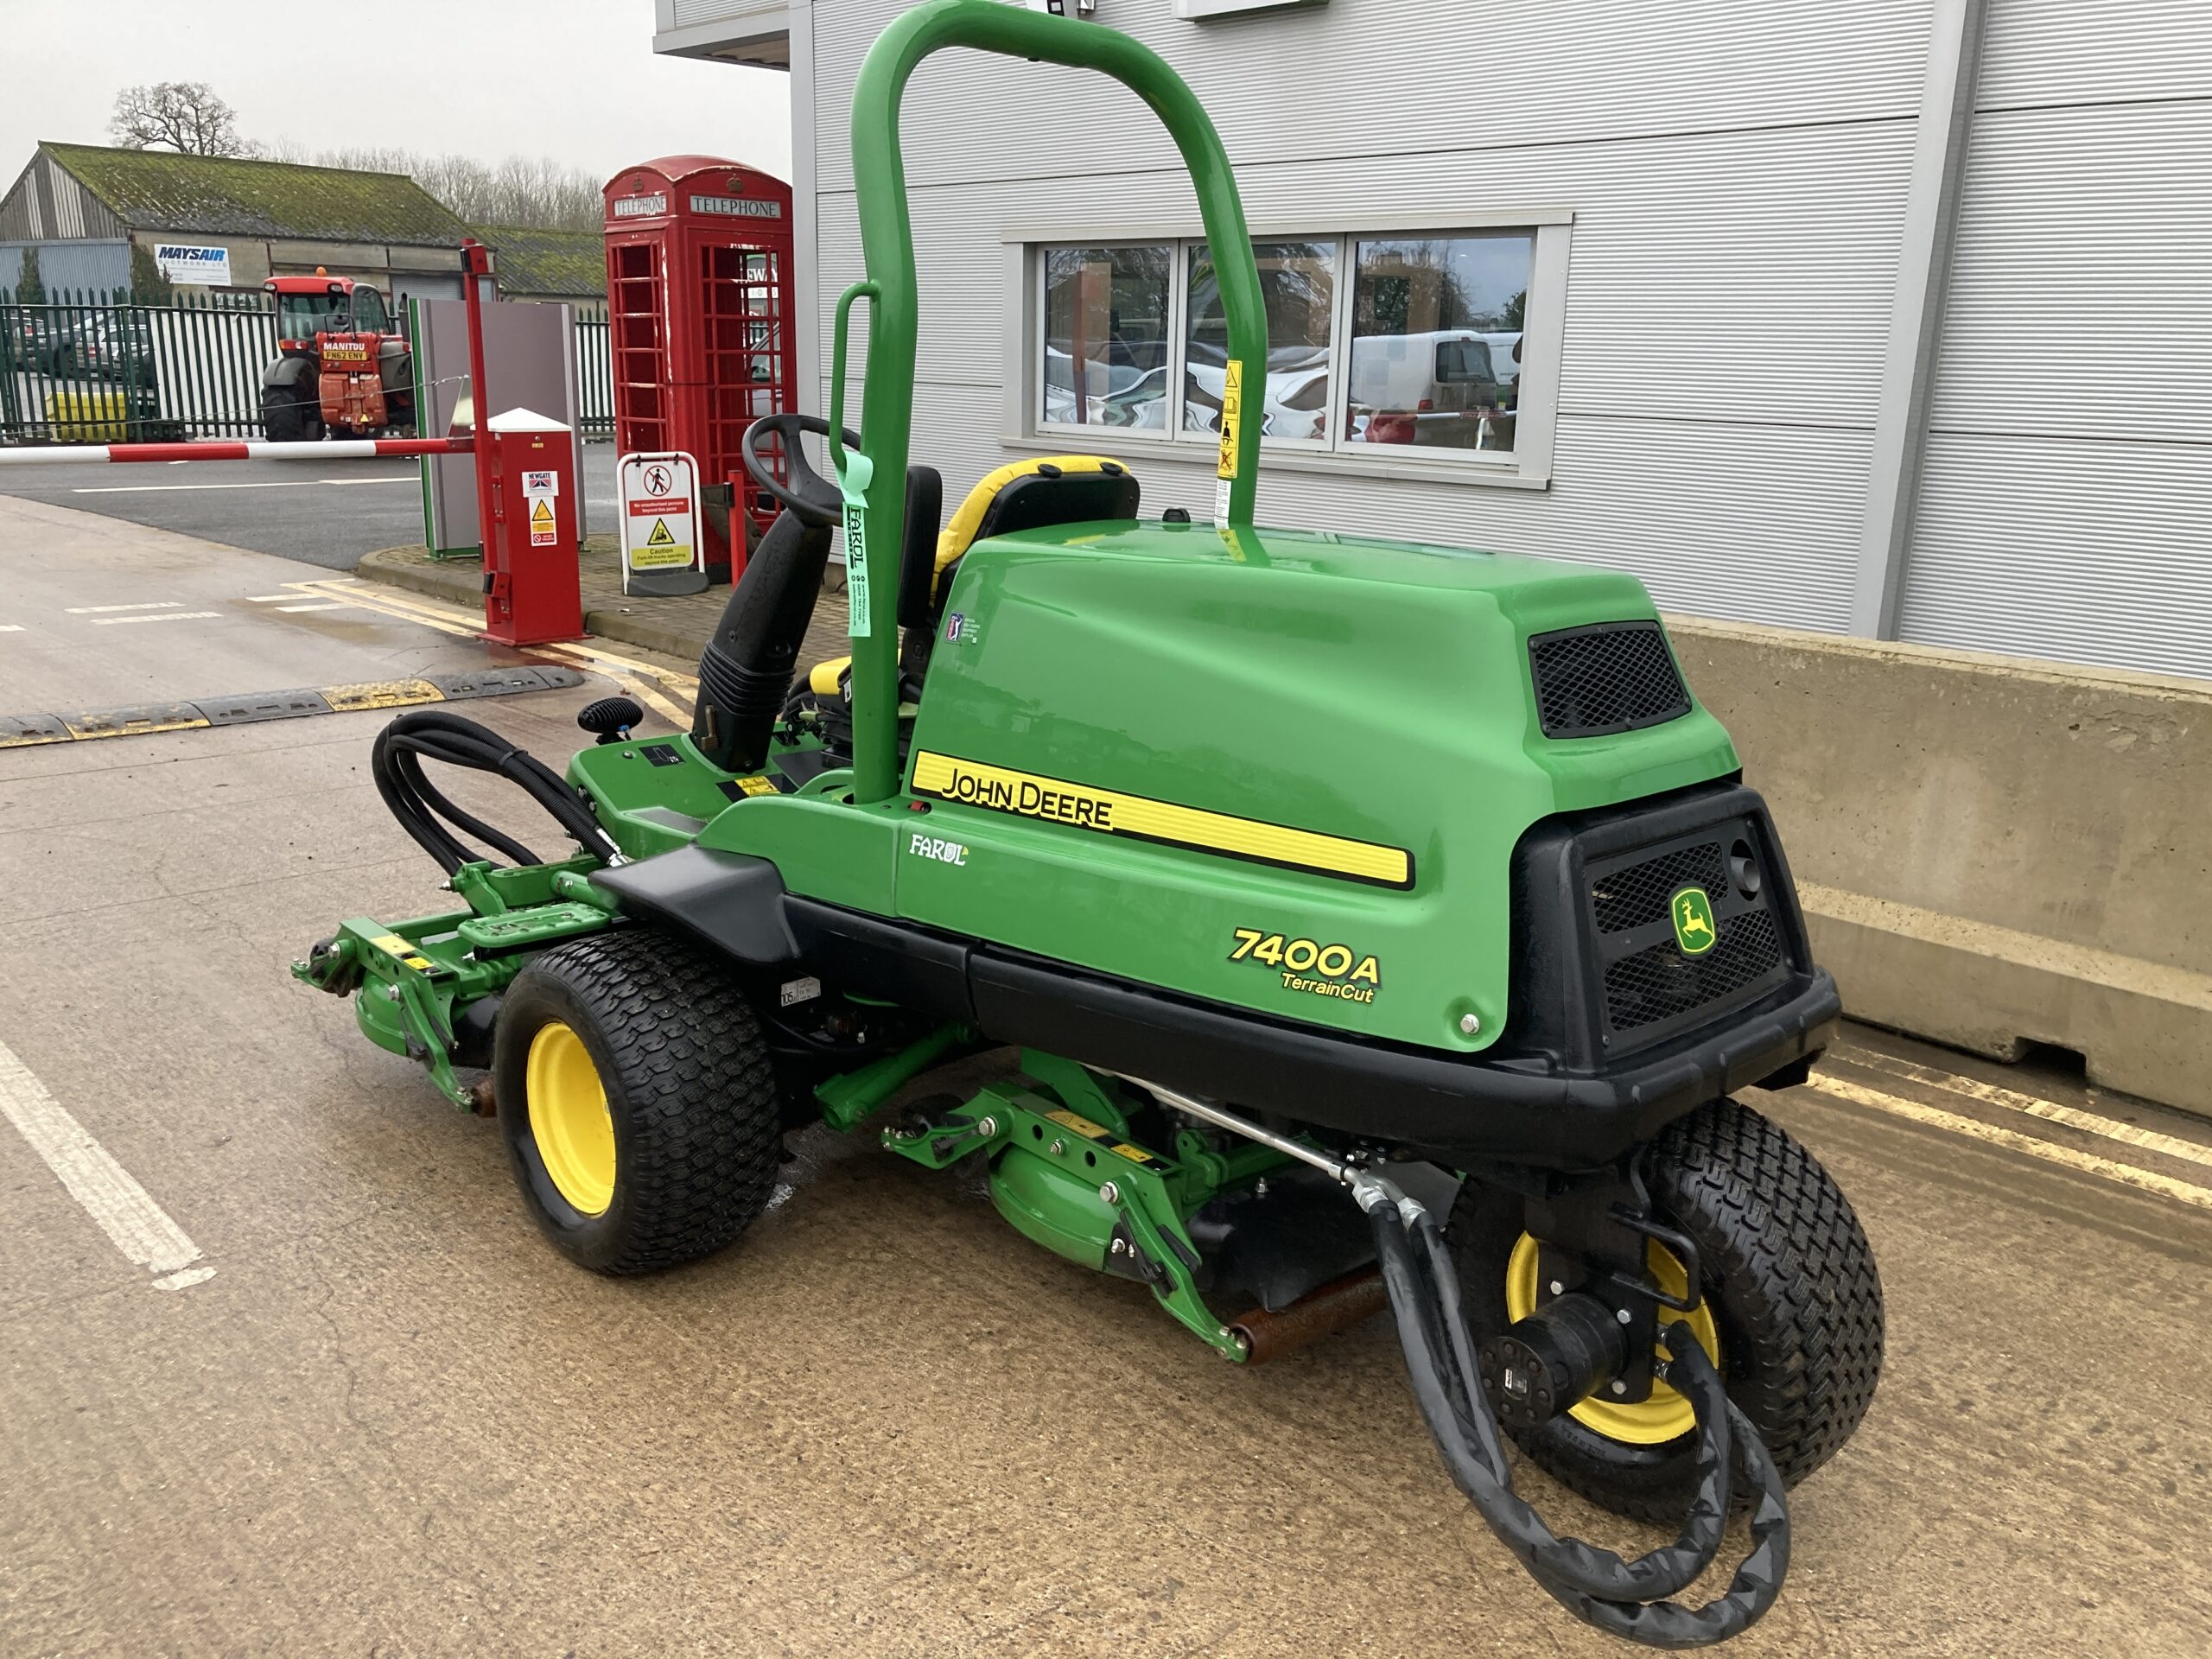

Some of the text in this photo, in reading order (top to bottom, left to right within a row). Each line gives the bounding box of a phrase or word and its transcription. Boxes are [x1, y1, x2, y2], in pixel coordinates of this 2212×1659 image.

[617, 195, 665, 214] TELEPHONE
[694, 197, 777, 216] TELEPHONE
[158, 247, 226, 261] MAYSAIR
[323, 342, 365, 351] MANITOU
[851, 508, 863, 568] FAROL
[942, 768, 1113, 826] JOHN DEERE
[909, 833, 966, 866] FAROL
[1229, 927, 1380, 985] 7400A
[1281, 972, 1374, 1004] TerrainCut
